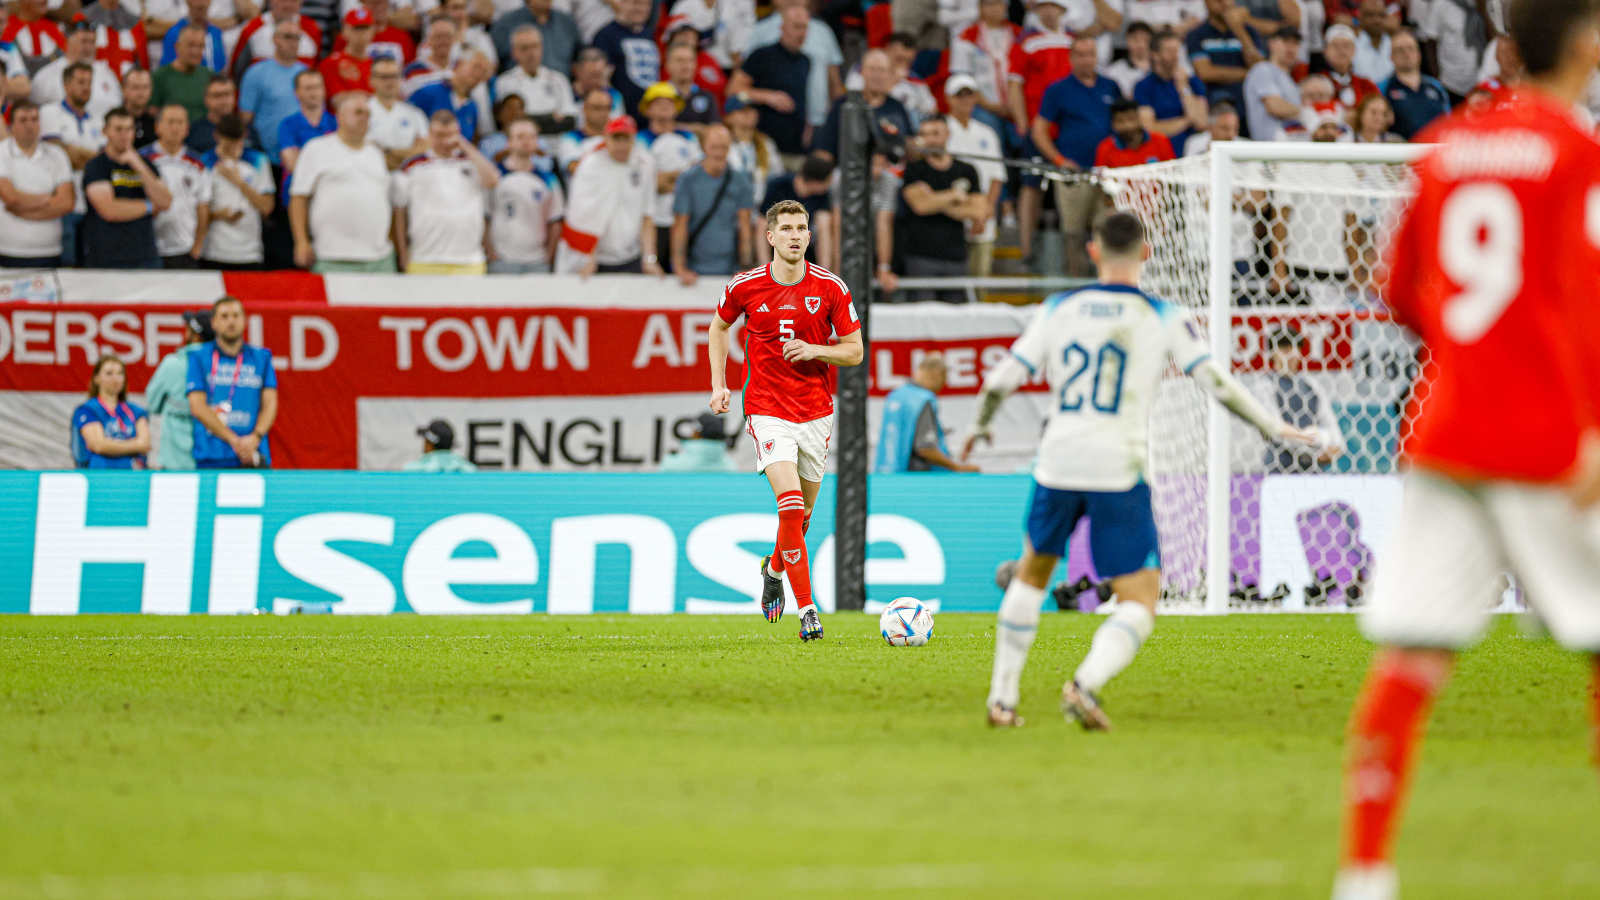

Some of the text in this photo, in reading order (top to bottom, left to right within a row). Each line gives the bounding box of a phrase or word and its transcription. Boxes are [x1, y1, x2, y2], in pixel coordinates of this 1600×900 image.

[1438, 182, 1525, 345] 9
[379, 316, 590, 371] TOWN
[779, 319, 795, 343] 5
[1058, 340, 1128, 414] 20
[30, 473, 946, 616] Hisense
